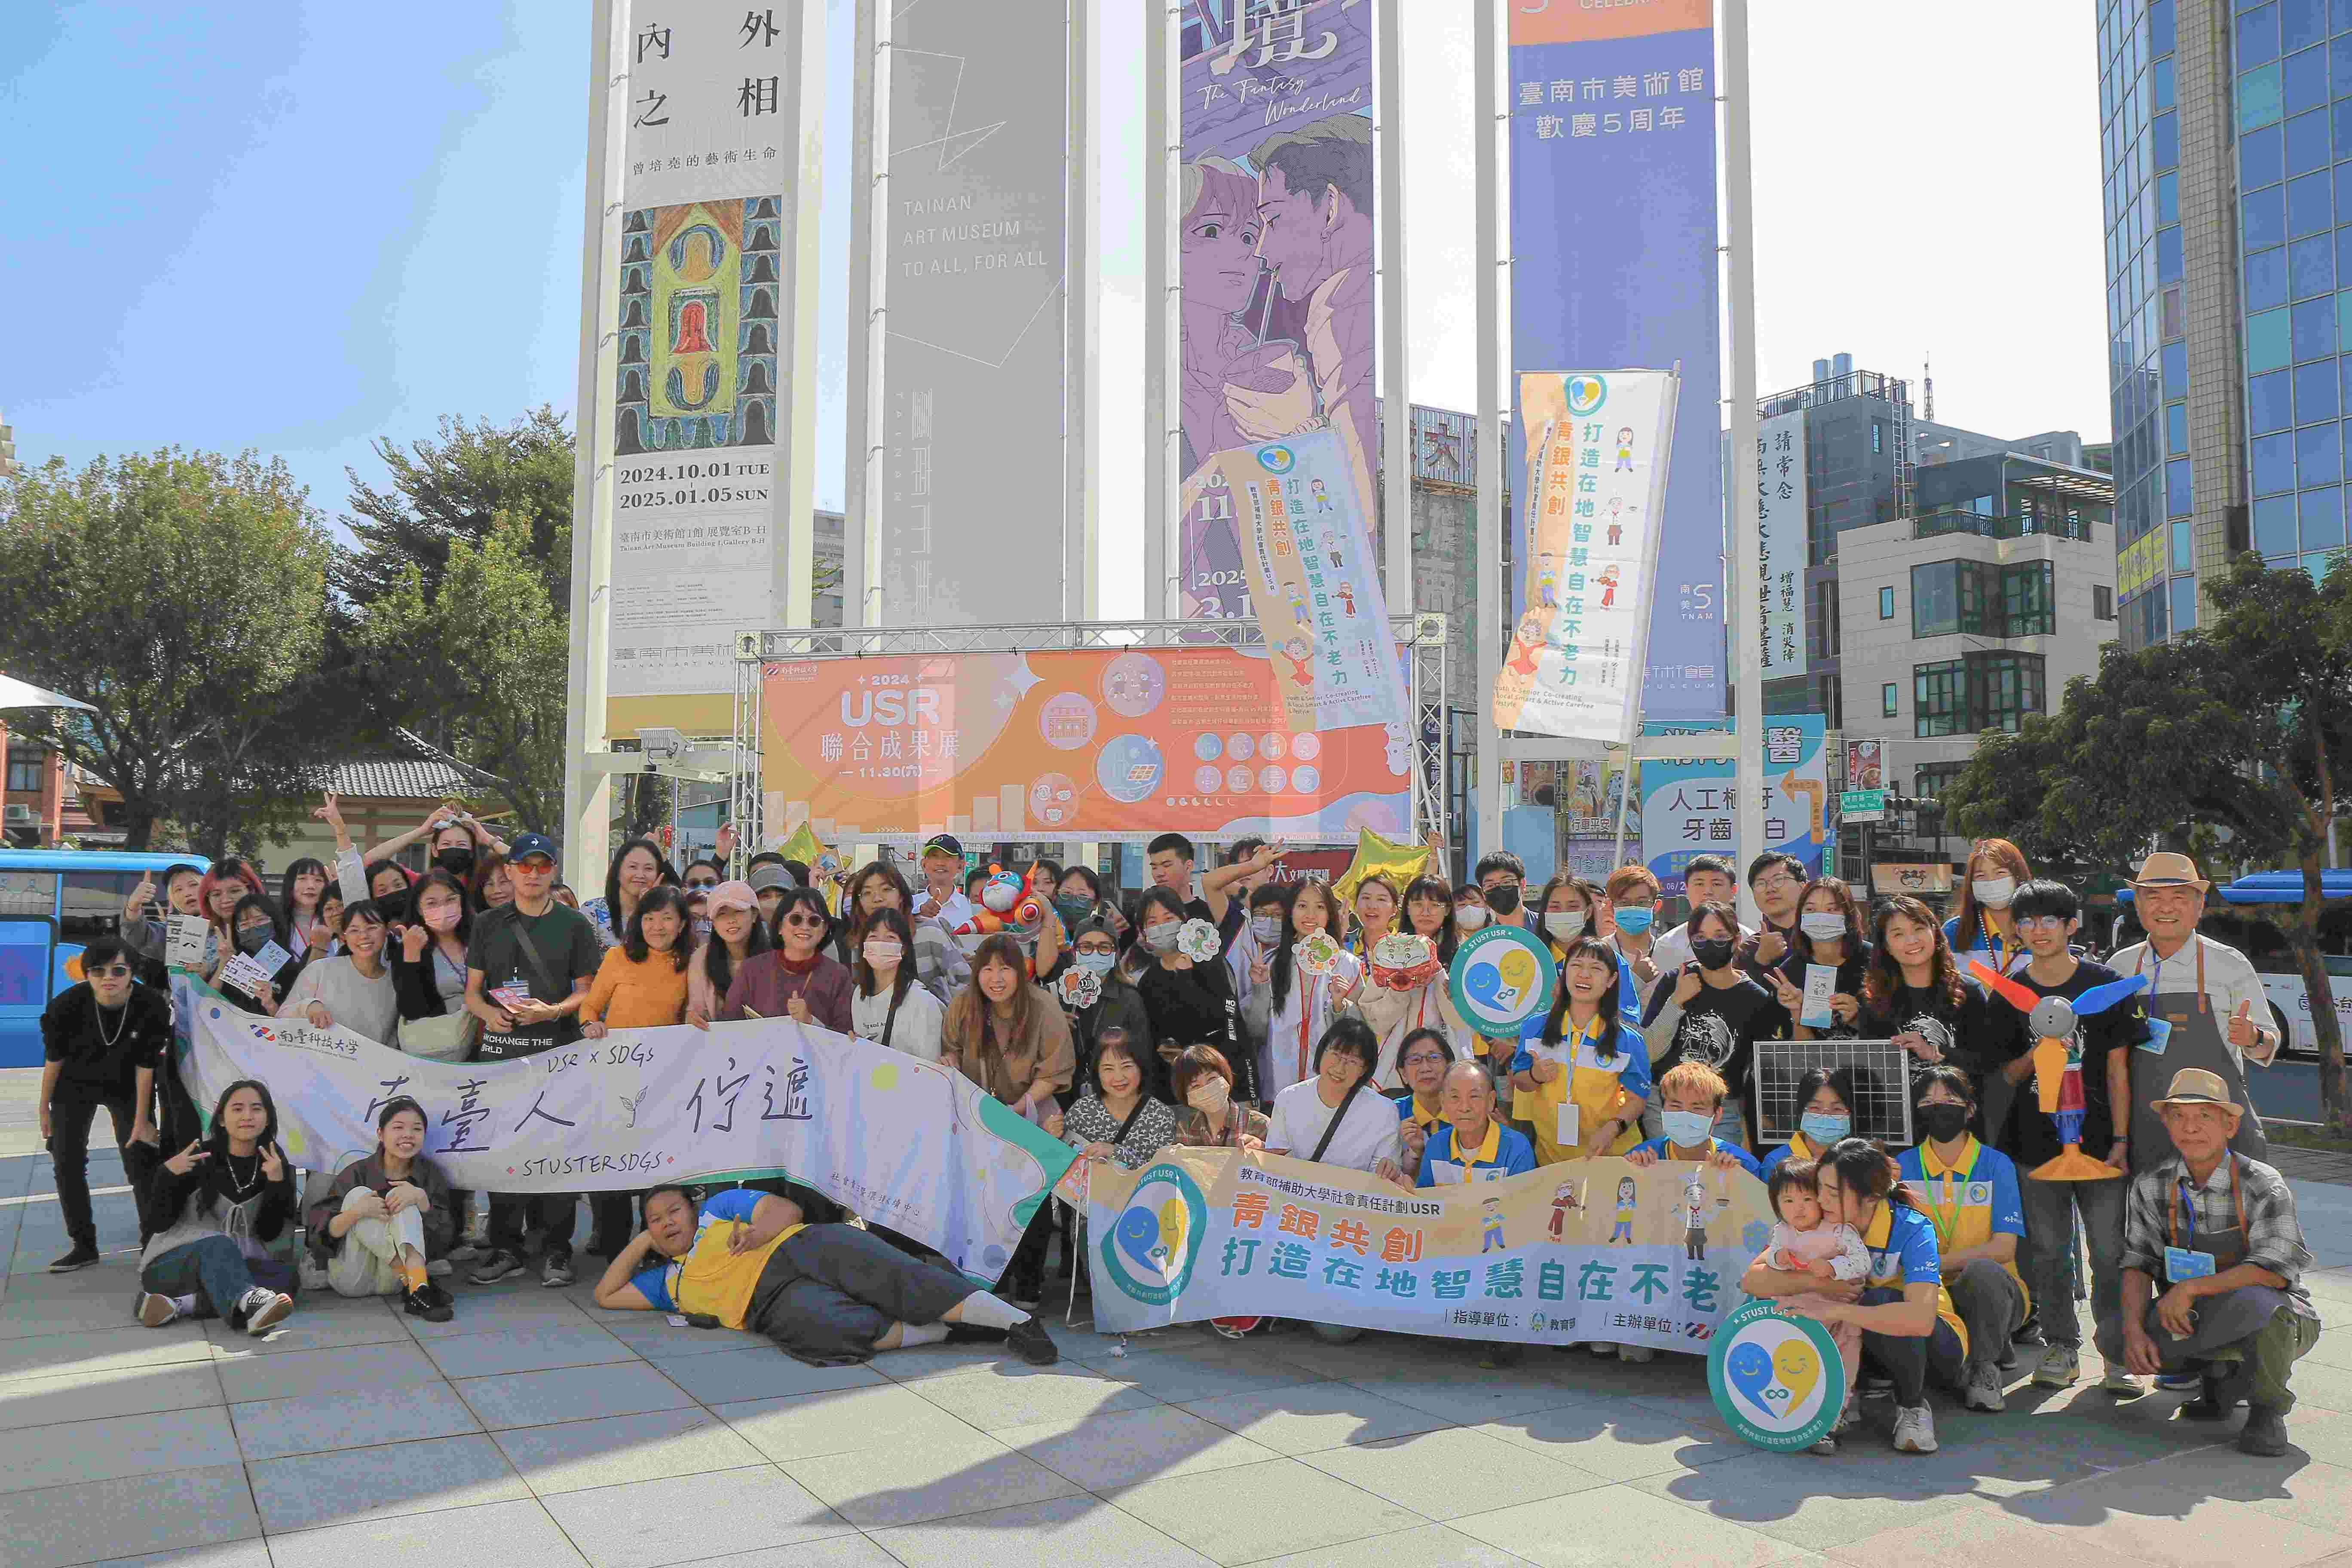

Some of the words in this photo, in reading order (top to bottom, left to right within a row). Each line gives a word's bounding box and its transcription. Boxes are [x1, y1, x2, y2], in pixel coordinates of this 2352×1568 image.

[1197, 83, 1228, 110] The
[1233, 76, 1307, 103] Fantasy
[1519, 67, 1704, 105] 臺南市美術館
[1265, 87, 1362, 126] Wonderland
[1536, 107, 1685, 140] 歡慶5周年
[632, 146, 778, 176] 曾培堯的藝術生命
[903, 195, 972, 215] TAINAN
[903, 226, 936, 246] ART
[942, 220, 1021, 242] MUSEUM
[903, 260, 922, 278] TO
[930, 257, 968, 276] ALL,
[973, 254, 1008, 270] FOR
[1014, 250, 1048, 266] ALL
[620, 462, 731, 484] 2024.10.01
[736, 463, 770, 476] TUE
[1547, 421, 1574, 517] 青銀共創
[619, 487, 732, 509] 2025.01.05
[735, 488, 769, 502] SUN
[1265, 478, 1293, 558] 青銀共創
[1559, 423, 1604, 686] 打造在地智慧自在不老力
[1286, 478, 1349, 686] 打造在地智慧自在不老力
[871, 674, 910, 686] 2024
[840, 688, 940, 727] USR
[820, 729, 961, 763] 聯合成果展
[859, 764, 923, 778] 11.30(六)
[1682, 817, 1785, 841] 牙齒白
[1468, 932, 1490, 949] STUST
[1491, 929, 1506, 937] USR
[531, 1038, 553, 1046] THE
[1140, 1172, 1157, 1185] TUST
[1158, 1169, 1174, 1177] USR
[1410, 1203, 1441, 1216] USR
[1232, 1192, 1424, 1262] 青銀共創
[1221, 1236, 1741, 1313] 打造在地智慧自在不老
[1740, 1307, 1768, 1322] STUST
